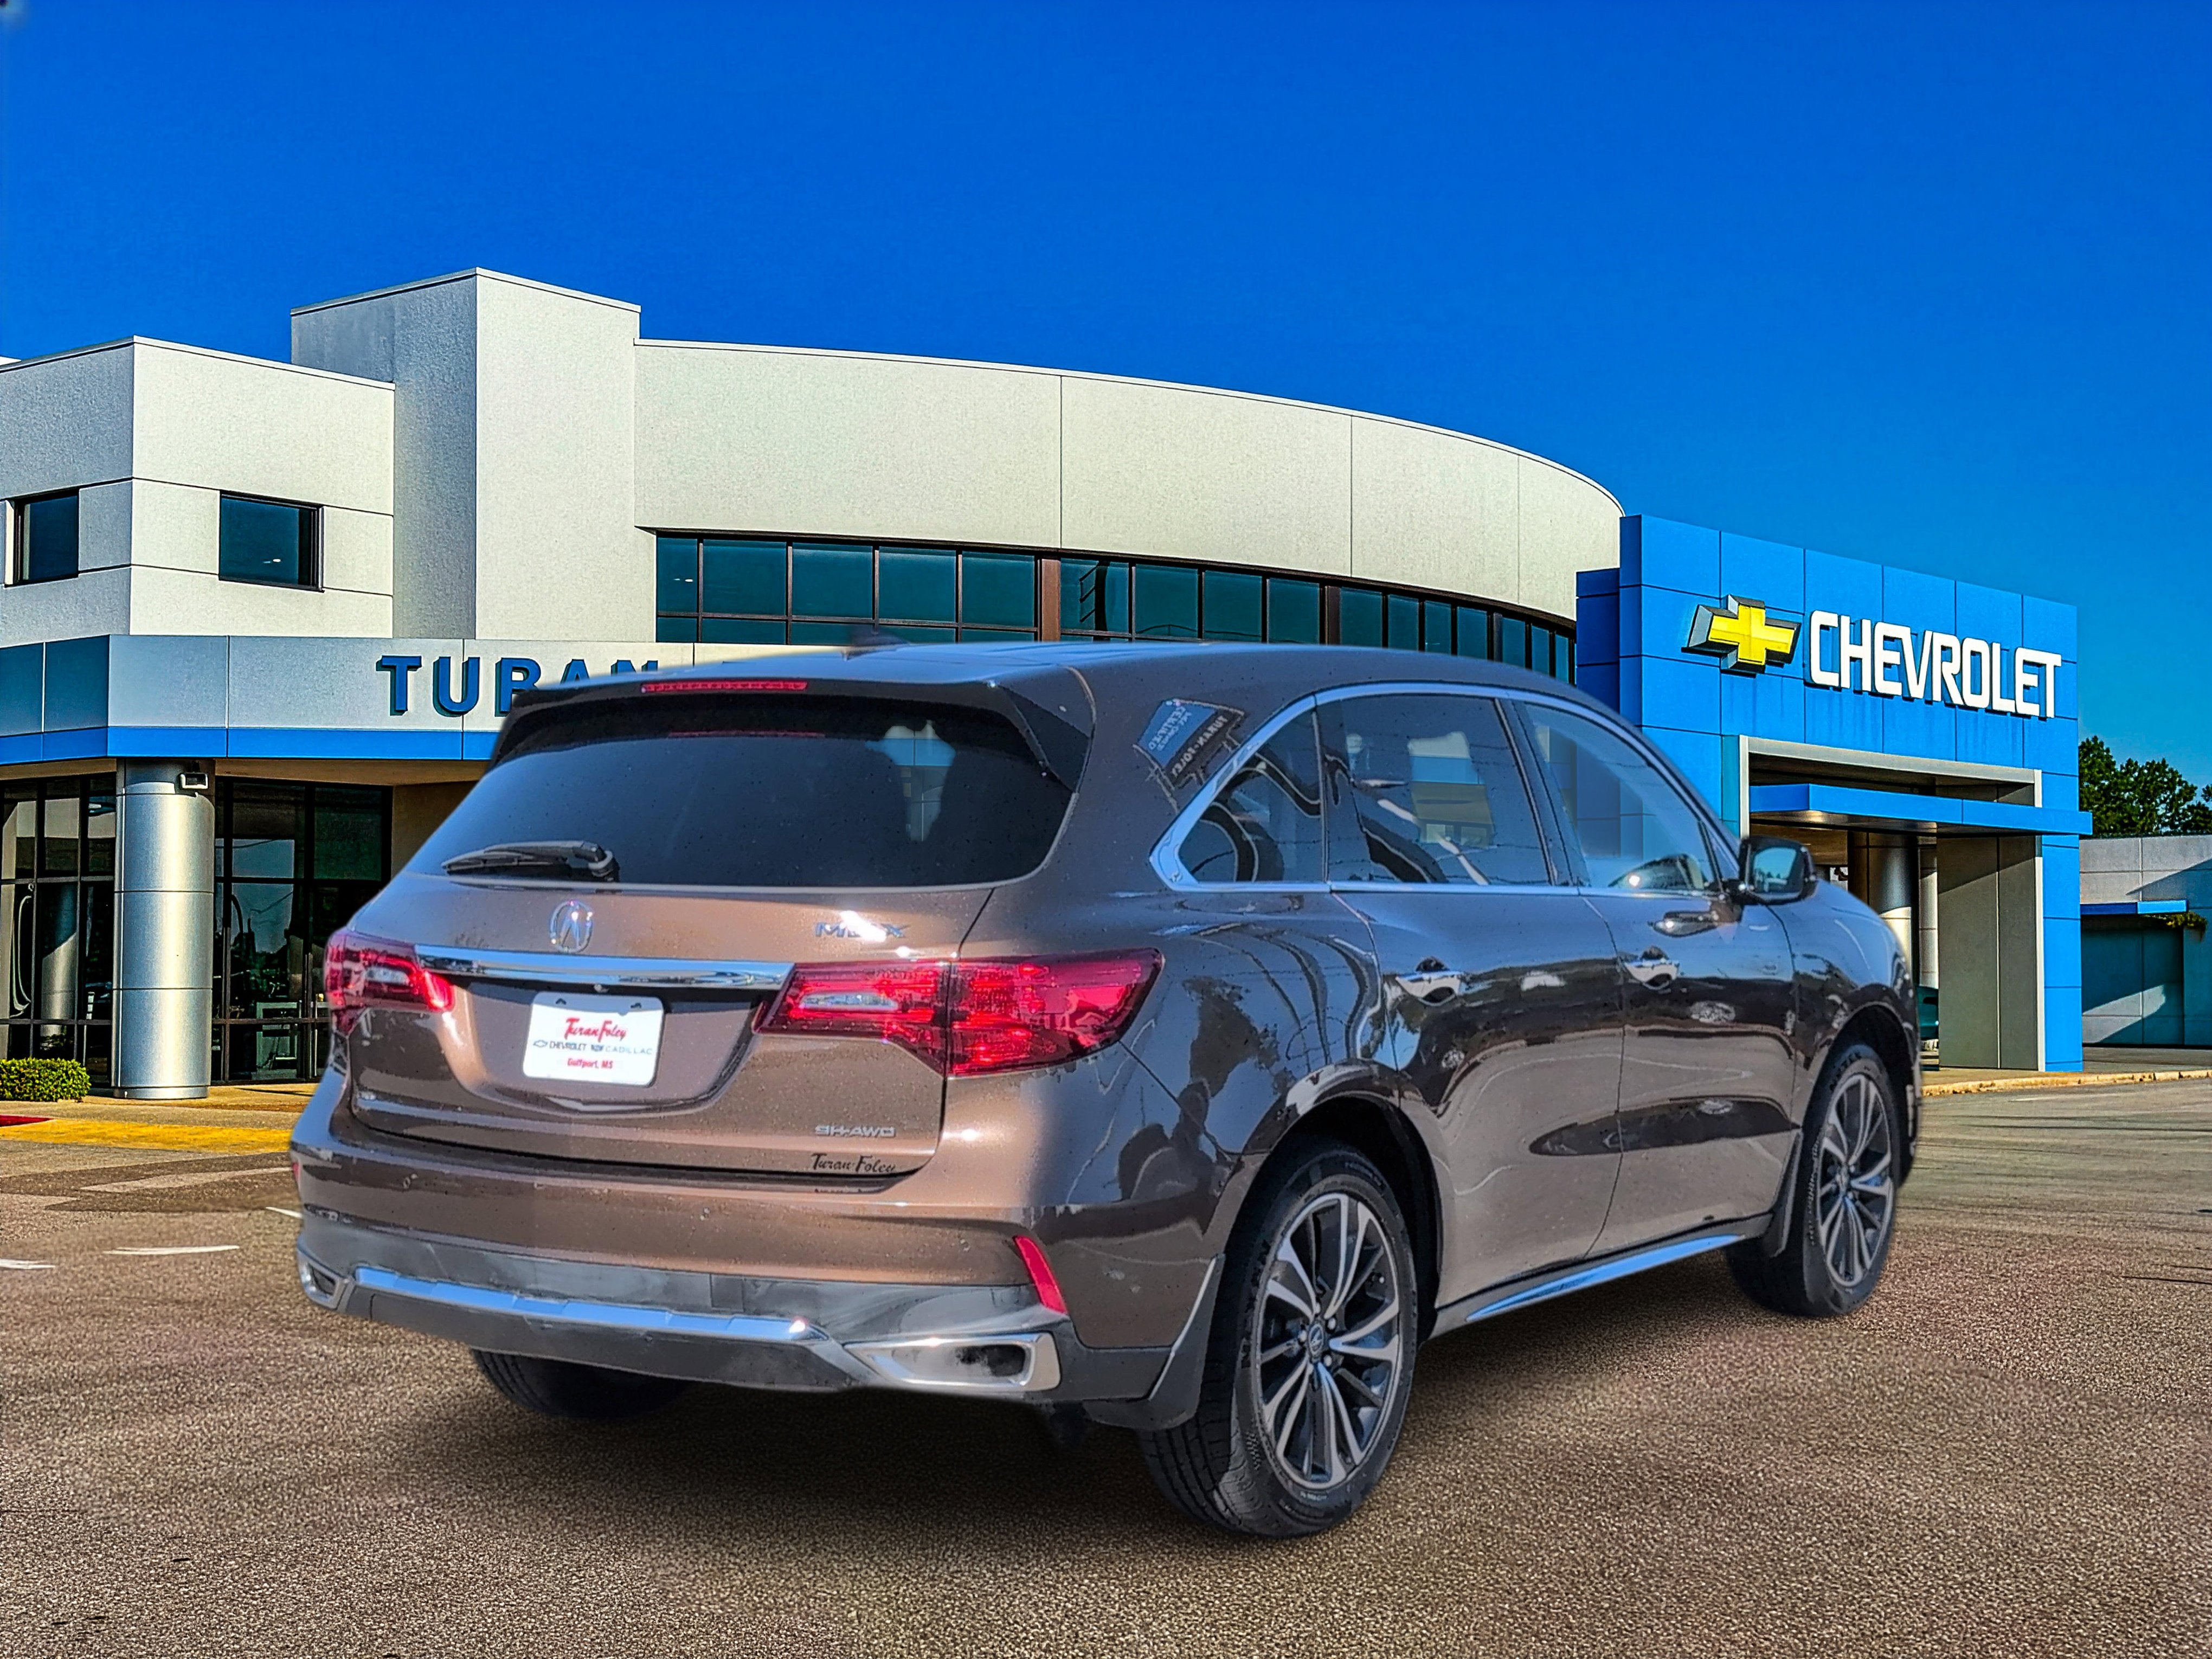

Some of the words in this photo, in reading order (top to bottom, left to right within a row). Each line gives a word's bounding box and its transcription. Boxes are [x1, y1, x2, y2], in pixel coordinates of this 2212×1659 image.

[1809, 609, 2062, 719] CHEVROLET
[376, 654, 658, 717] TUR
[815, 922, 911, 938] MX
[605, 1044, 653, 1055] CADILLAC
